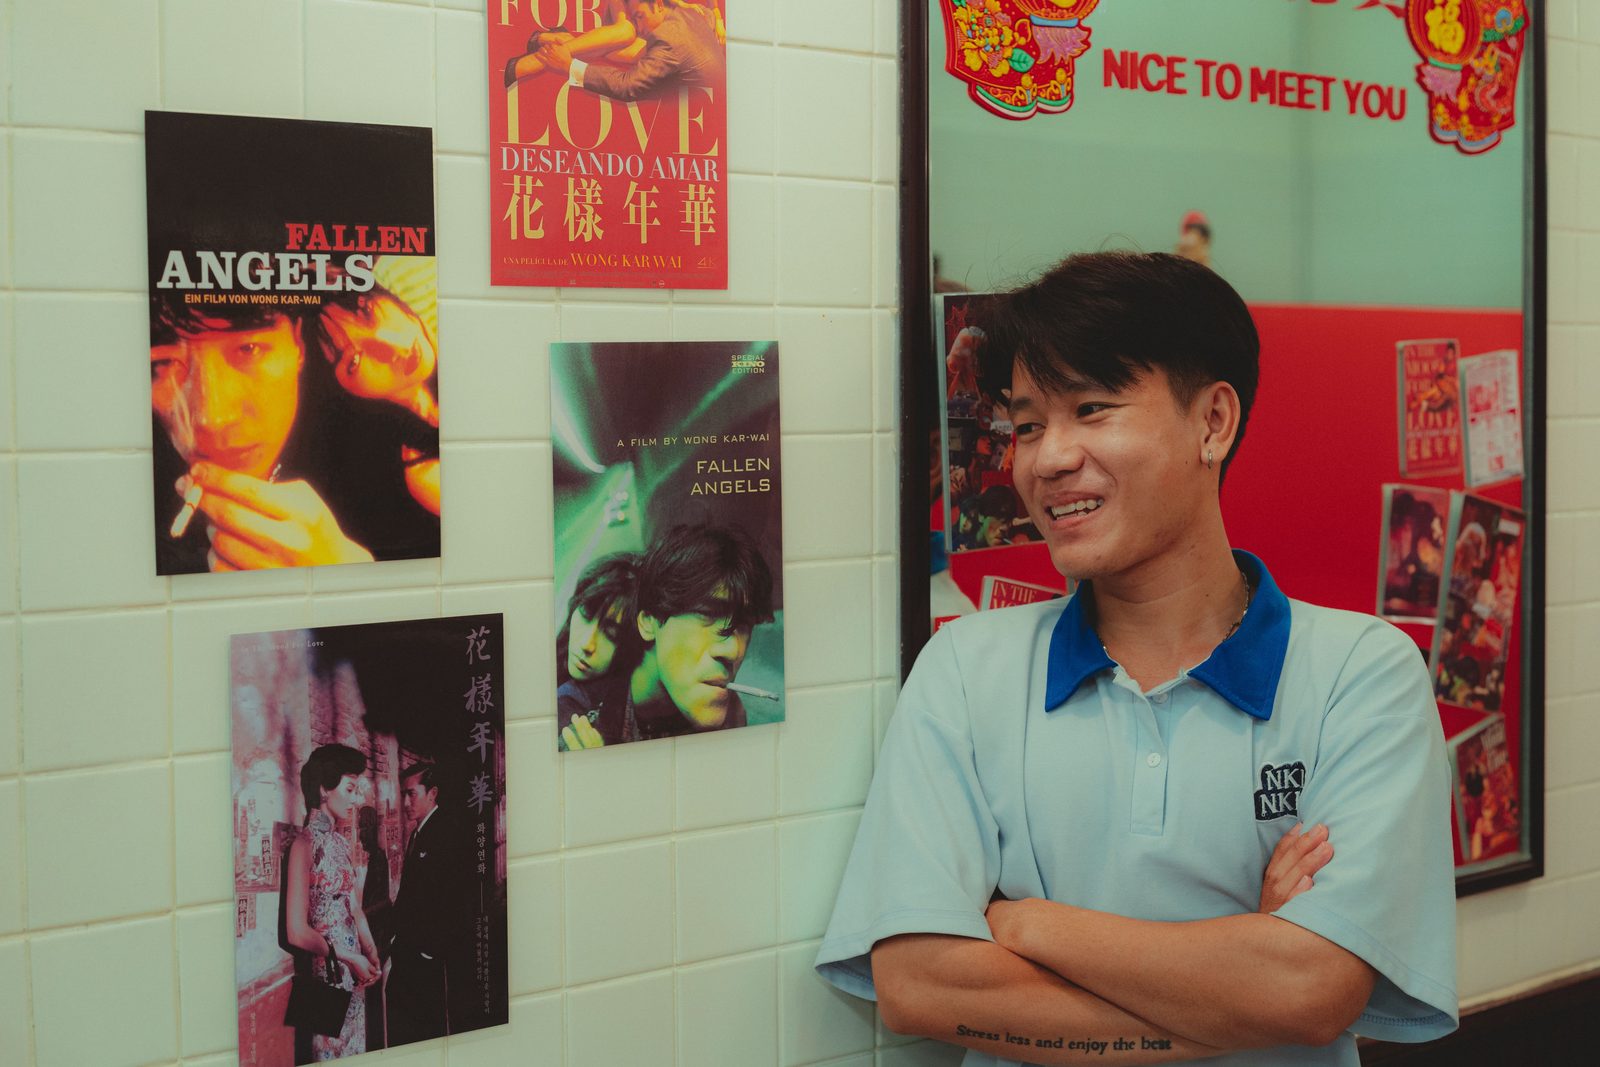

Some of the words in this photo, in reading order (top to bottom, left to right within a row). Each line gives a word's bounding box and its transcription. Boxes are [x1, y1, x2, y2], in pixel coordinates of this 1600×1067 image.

[497, 0, 602, 33] FOR
[1103, 48, 1187, 95] NICE
[1194, 59, 1242, 101] TO
[1250, 68, 1336, 112] MEET
[1342, 80, 1406, 121] YOU
[499, 78, 719, 157] LOVE
[500, 146, 644, 178] DESEANDO
[650, 155, 720, 182] AMAR
[503, 174, 718, 246] 花樣年華
[285, 223, 428, 253] FALLEN
[156, 250, 375, 292] ANGELS
[503, 256, 520, 265] UNA
[558, 258, 569, 266] DE
[570, 253, 618, 267] WONG
[184, 293, 202, 304] EIN
[203, 294, 227, 304] FILM
[228, 294, 248, 304] VON
[250, 295, 279, 305] WONG
[280, 295, 321, 305] KAR-WAI
[731, 360, 766, 368] KINO
[617, 439, 624, 447] A
[631, 438, 657, 447] FILM
[663, 437, 678, 446] BY
[683, 435, 717, 445] WONG
[723, 433, 770, 443] KAR-WAI
[697, 457, 770, 474] FALLEN
[690, 478, 771, 496] ANGELS
[993, 581, 1007, 598] IN
[1010, 585, 1037, 603] THE
[307, 640, 324, 648] Love
[463, 625, 495, 815] 花樣年華
[956, 1024, 1000, 1041] Stress
[1005, 1032, 1031, 1046] less
[1035, 1037, 1063, 1050] and
[1068, 1040, 1109, 1055] enjoy
[1112, 1037, 1136, 1051] the
